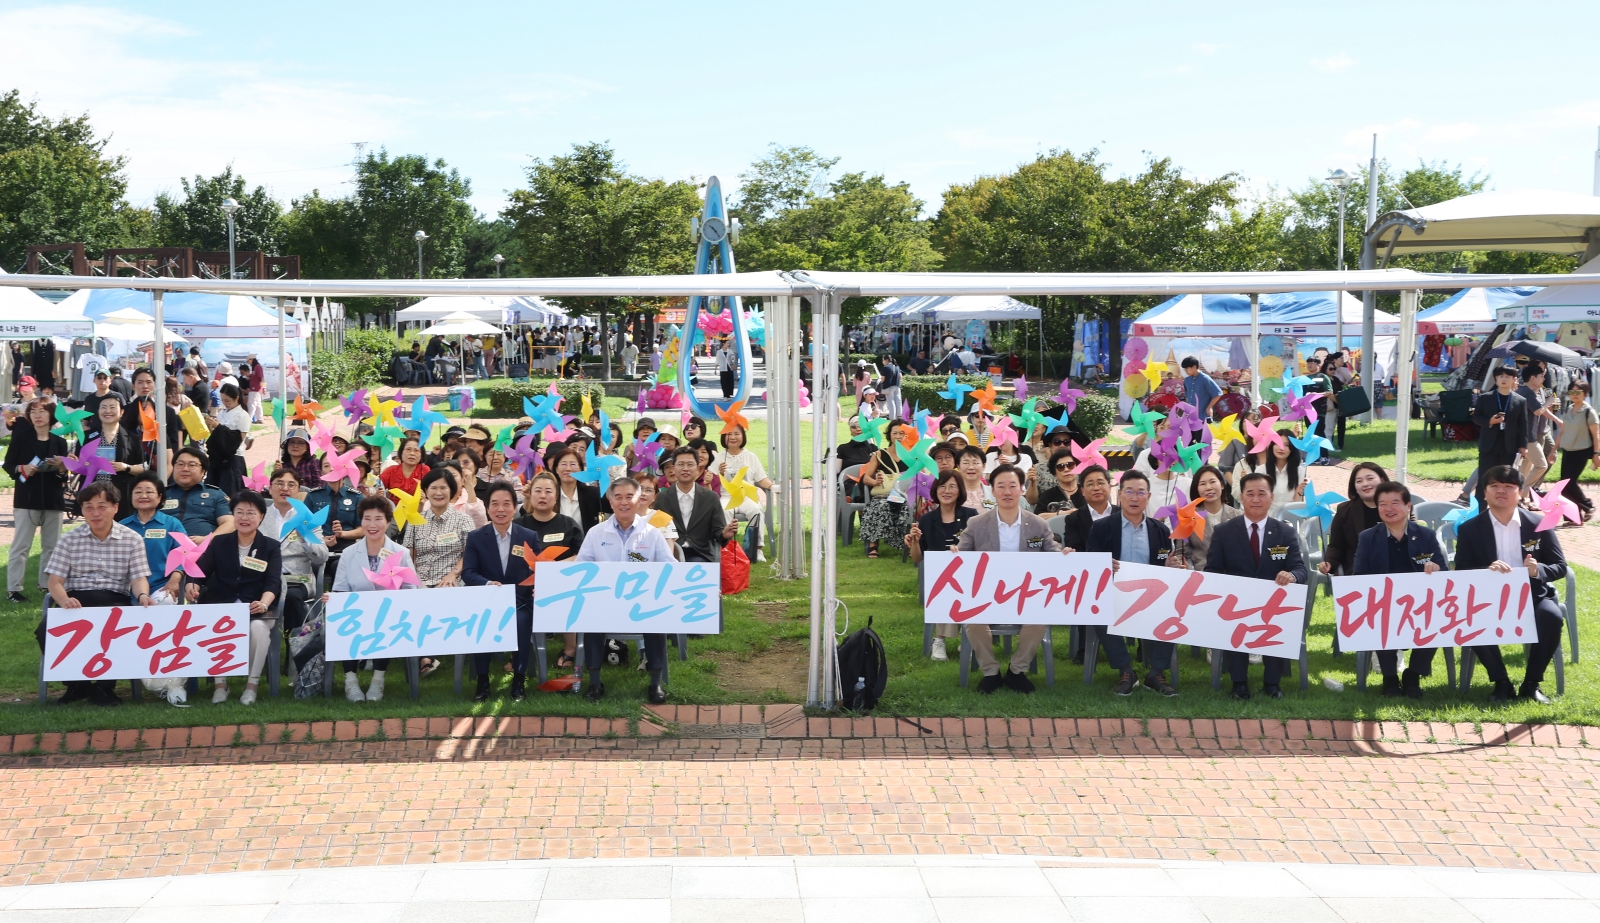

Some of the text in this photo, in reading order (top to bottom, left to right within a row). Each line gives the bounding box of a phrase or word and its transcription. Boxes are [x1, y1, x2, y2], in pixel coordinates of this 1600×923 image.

[6, 325, 20, 333] 나눔
[21, 325, 36, 334] 장터
[535, 562, 719, 631] 구민을
[926, 552, 1112, 622] 신나게!
[1113, 572, 1304, 649] 강남
[1336, 577, 1530, 648] 대전환!!
[47, 607, 248, 678] 강남을
[326, 592, 516, 660] 힘차게!
